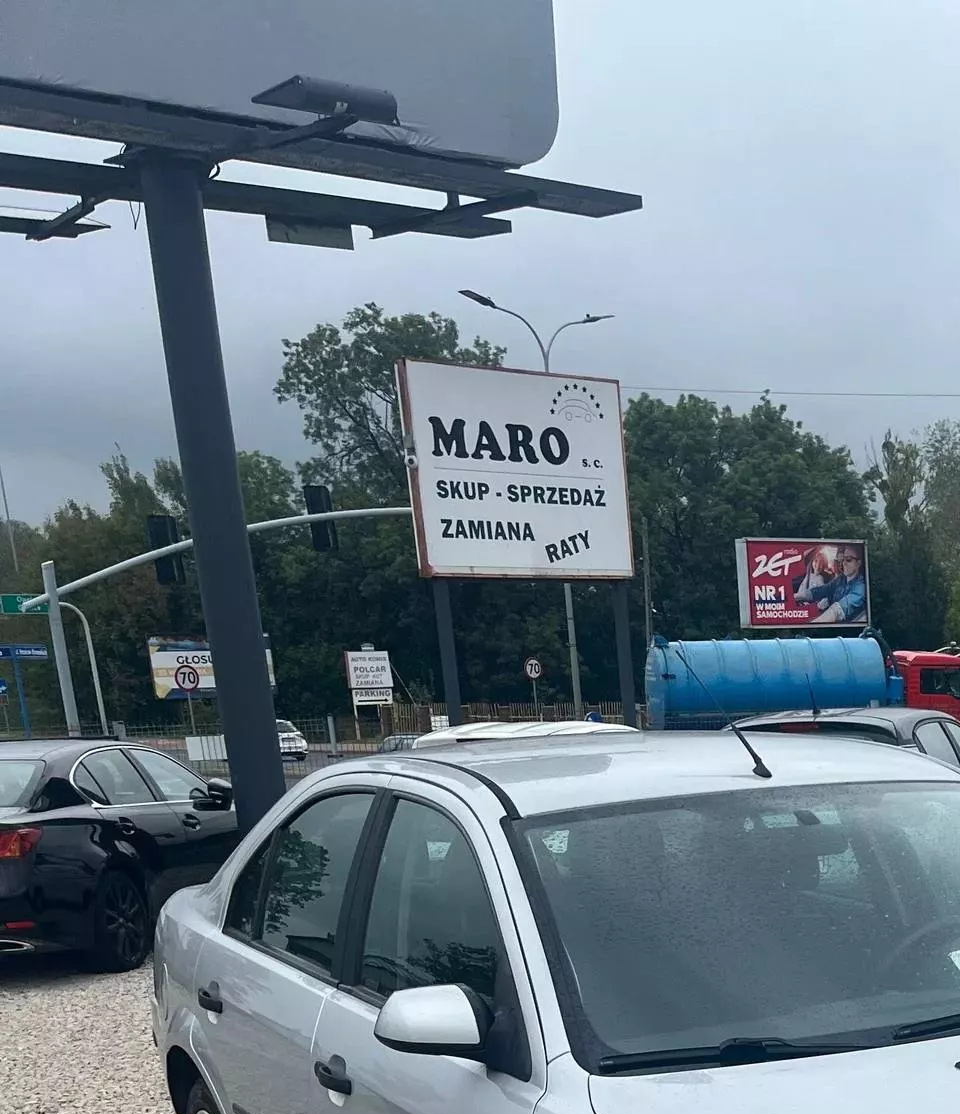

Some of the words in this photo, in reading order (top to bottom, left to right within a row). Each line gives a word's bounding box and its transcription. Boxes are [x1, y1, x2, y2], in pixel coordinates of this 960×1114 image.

[428, 416, 570, 465] MARO
[436, 480, 489, 500] SKUP
[507, 484, 606, 507] SPRZEDAŻ
[440, 518, 535, 542] ZAMIANA
[545, 530, 591, 563] RATY
[752, 552, 802, 578] ZET
[754, 585, 777, 601] NR
[778, 585, 785, 601] 1
[755, 603, 764, 611] W
[765, 602, 785, 610] MOIM
[756, 610, 809, 619] SAMOCHODZIE
[353, 665, 387, 674] POLCAR
[528, 663, 540, 674] 70
[179, 671, 196, 685] 70
[354, 690, 391, 698] PARKING
